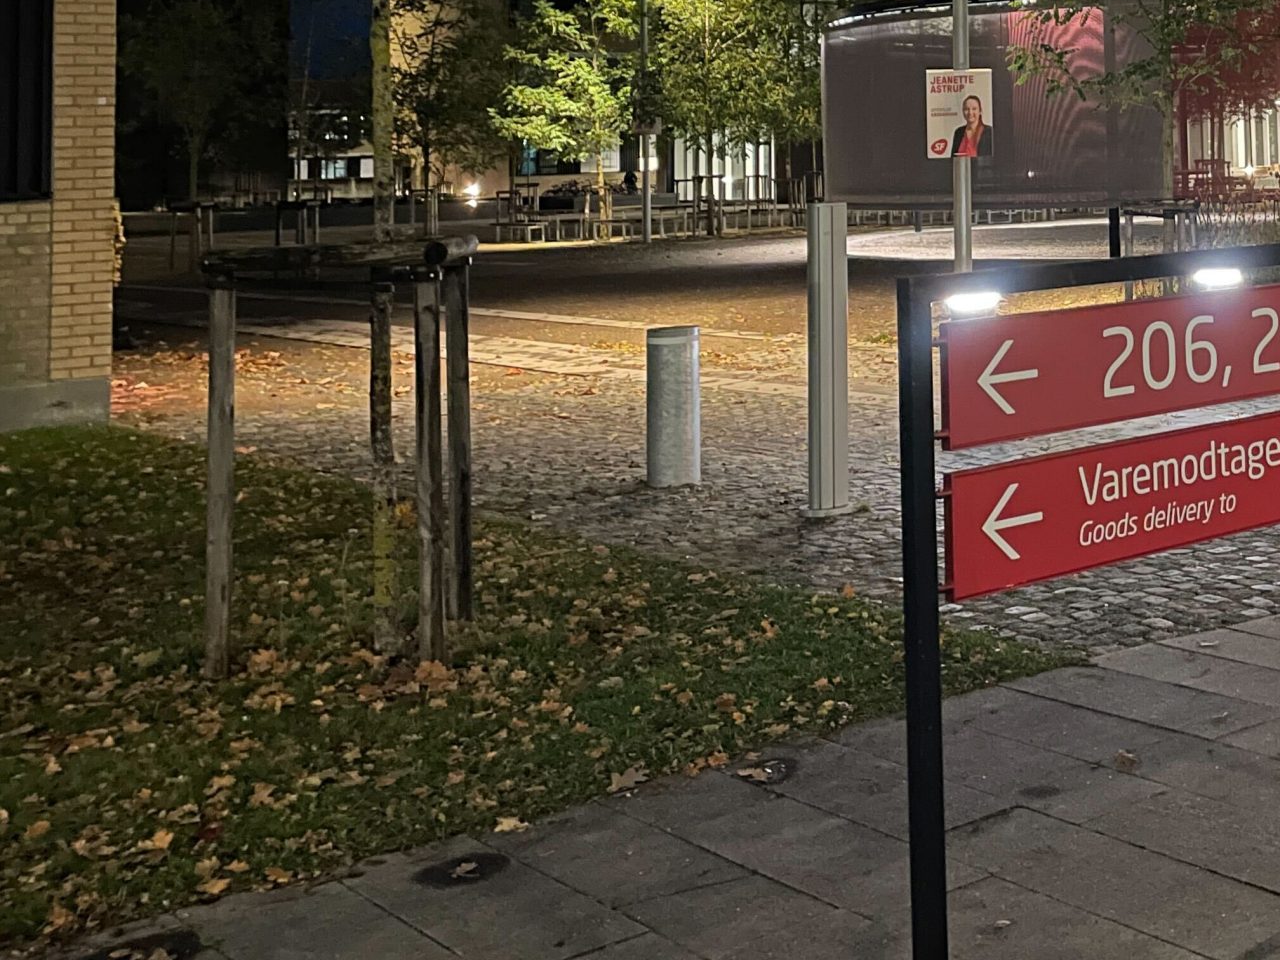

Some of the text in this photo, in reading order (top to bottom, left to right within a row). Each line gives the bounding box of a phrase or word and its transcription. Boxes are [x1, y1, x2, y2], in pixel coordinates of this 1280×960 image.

[930, 75, 974, 84] JEANETTE
[930, 85, 964, 93] ASTRUP
[934, 142, 945, 151] SF
[1102, 315, 1232, 398] 206,
[1079, 493, 1237, 546] Goods delivery to
